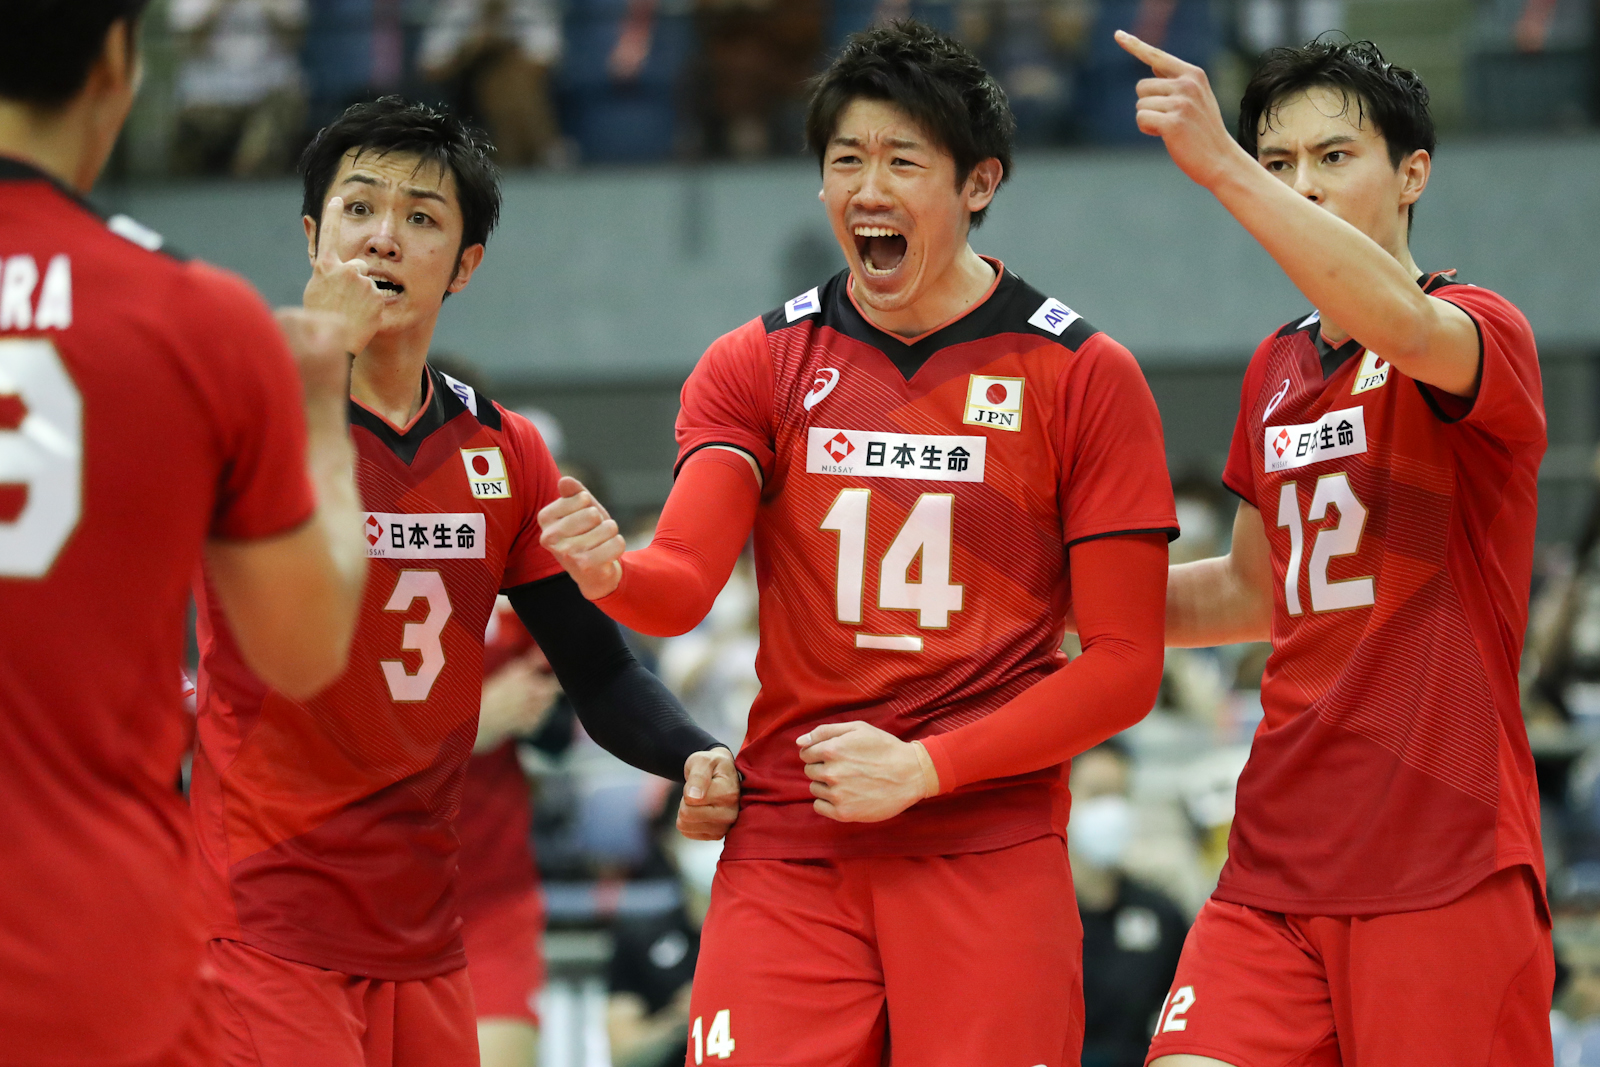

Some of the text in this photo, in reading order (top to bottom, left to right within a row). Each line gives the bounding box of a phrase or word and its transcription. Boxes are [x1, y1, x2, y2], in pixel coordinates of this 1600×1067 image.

[0, 253, 72, 330] RA
[1044, 303, 1070, 328] AN
[1361, 370, 1387, 389] JPN
[975, 410, 1014, 425] JPN
[821, 465, 853, 473] NISSAY
[866, 441, 970, 472] 日本生命
[475, 482, 502, 495] JPN
[391, 523, 475, 549] 日本生命
[1277, 472, 1376, 616] 12
[818, 488, 966, 629] 14
[379, 568, 454, 703] 3
[691, 1008, 736, 1066] 14
